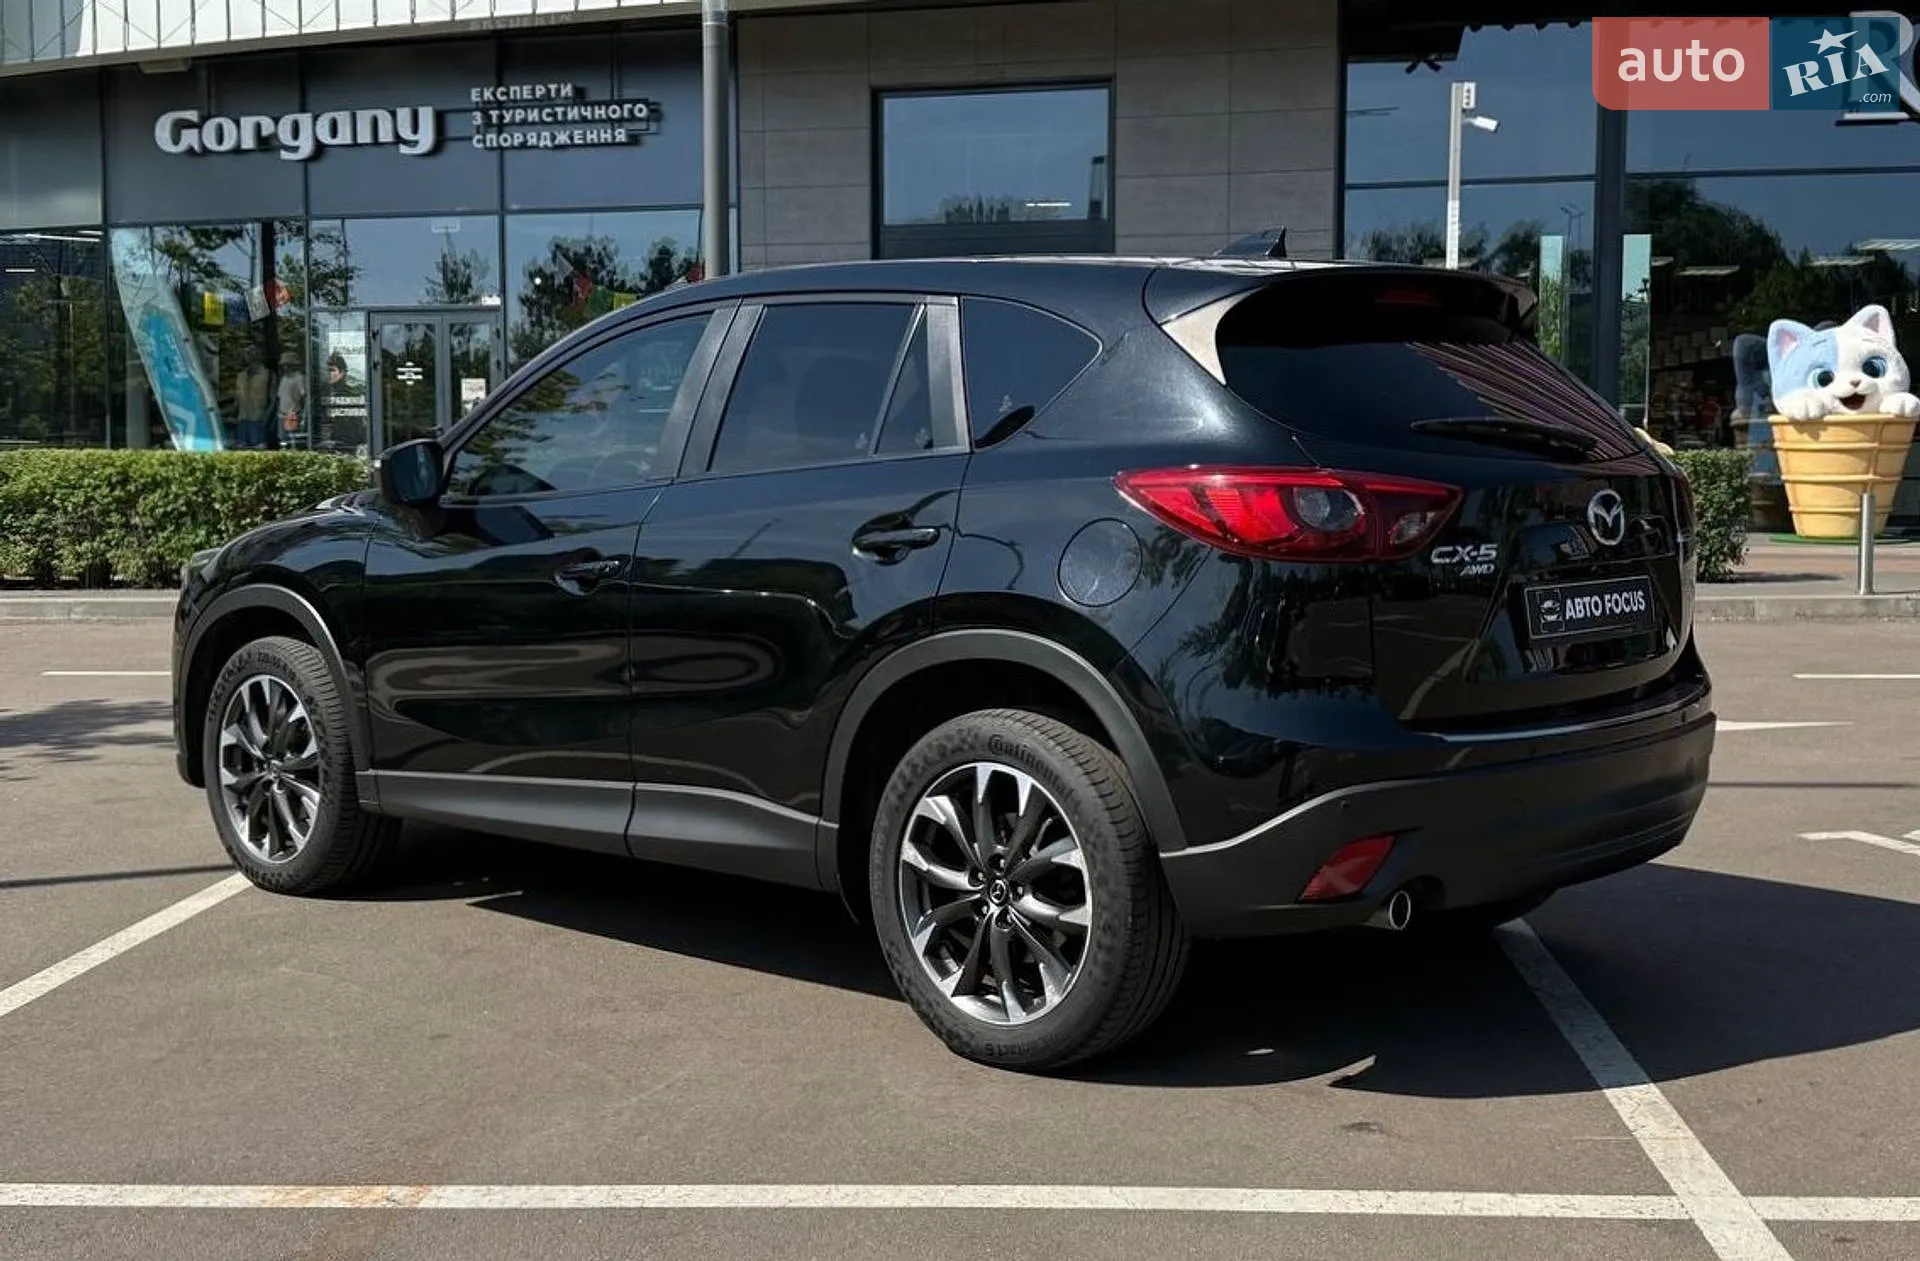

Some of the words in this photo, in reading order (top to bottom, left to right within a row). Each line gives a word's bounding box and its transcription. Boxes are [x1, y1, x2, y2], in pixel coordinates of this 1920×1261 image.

[470, 83, 574, 101] ЕКСПЕРТИ
[488, 103, 649, 124] ТУРИСТИЧНОГО
[154, 106, 434, 160] Gorgany
[472, 128, 628, 149] СПОРЯДЖЕННЯ
[1430, 543, 1498, 564] CX-5
[1459, 563, 1496, 577] AWD
[1604, 590, 1646, 615] FOCUS
